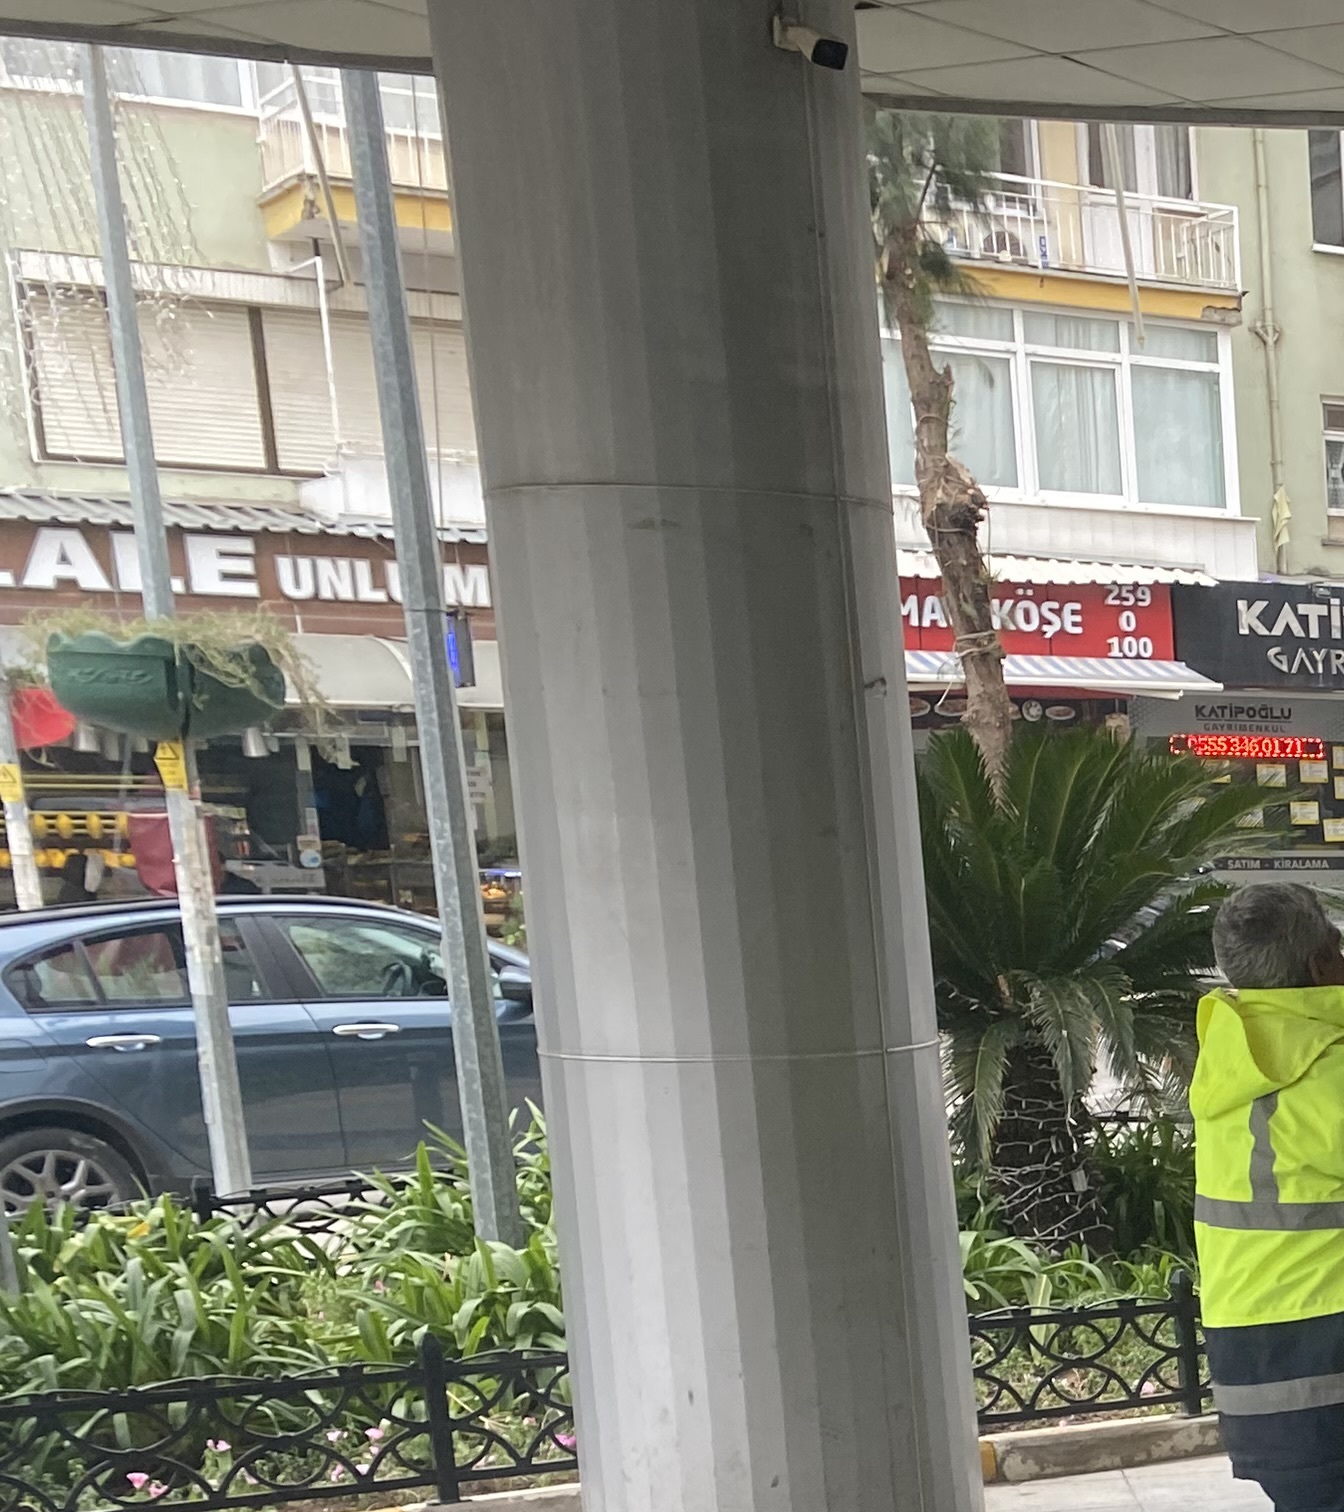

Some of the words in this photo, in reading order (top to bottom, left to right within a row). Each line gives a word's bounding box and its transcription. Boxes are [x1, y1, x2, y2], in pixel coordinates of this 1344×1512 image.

[0, 527, 261, 598] ALE
[1104, 584, 1152, 607] 259
[991, 588, 1084, 639] KÖŞE
[1119, 611, 1136, 632] 0
[1107, 636, 1153, 658] 100
[1195, 702, 1292, 721] KATİPOĞLU
[1227, 859, 1261, 870] SATIM
[1274, 857, 1330, 870] KİRALAMA
